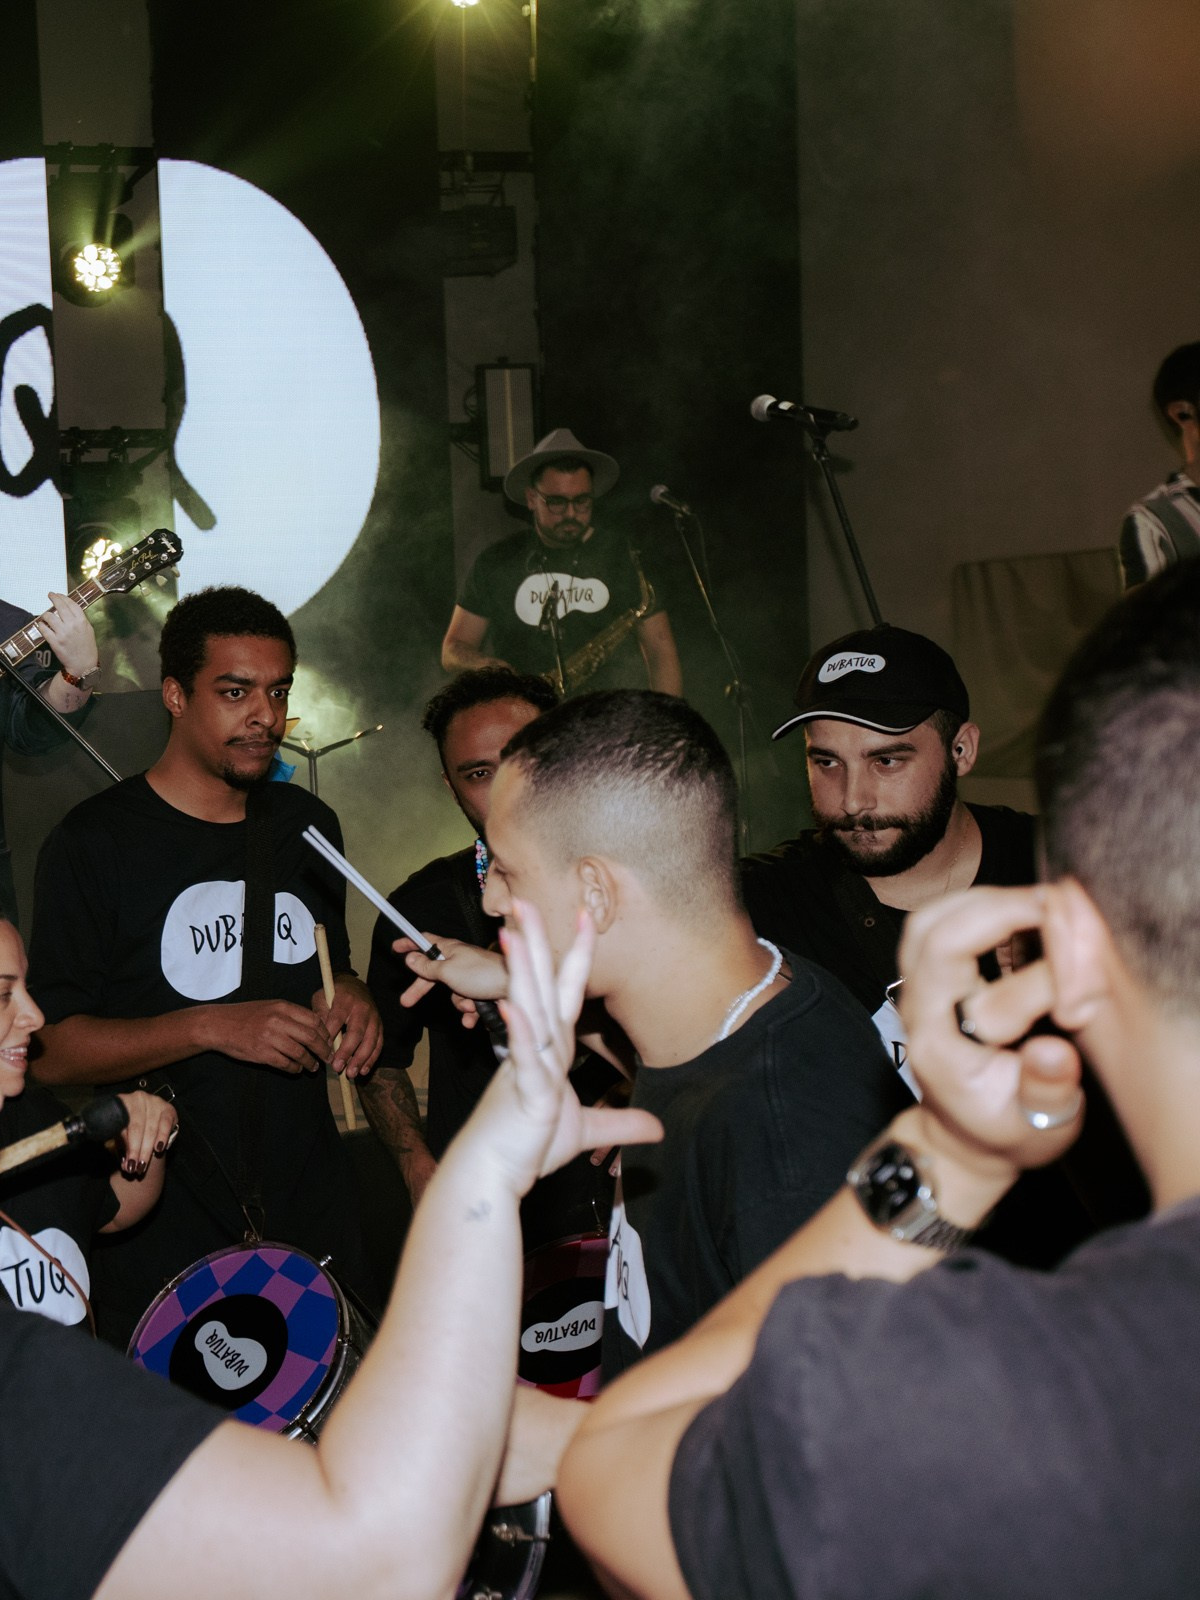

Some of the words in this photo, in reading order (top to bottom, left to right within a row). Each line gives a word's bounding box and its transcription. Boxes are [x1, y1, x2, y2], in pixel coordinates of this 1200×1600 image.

[826, 656, 877, 673] DUBATUQ
[534, 1317, 597, 1344] DUBATUQ
[205, 1328, 250, 1378] DUBATUQ
